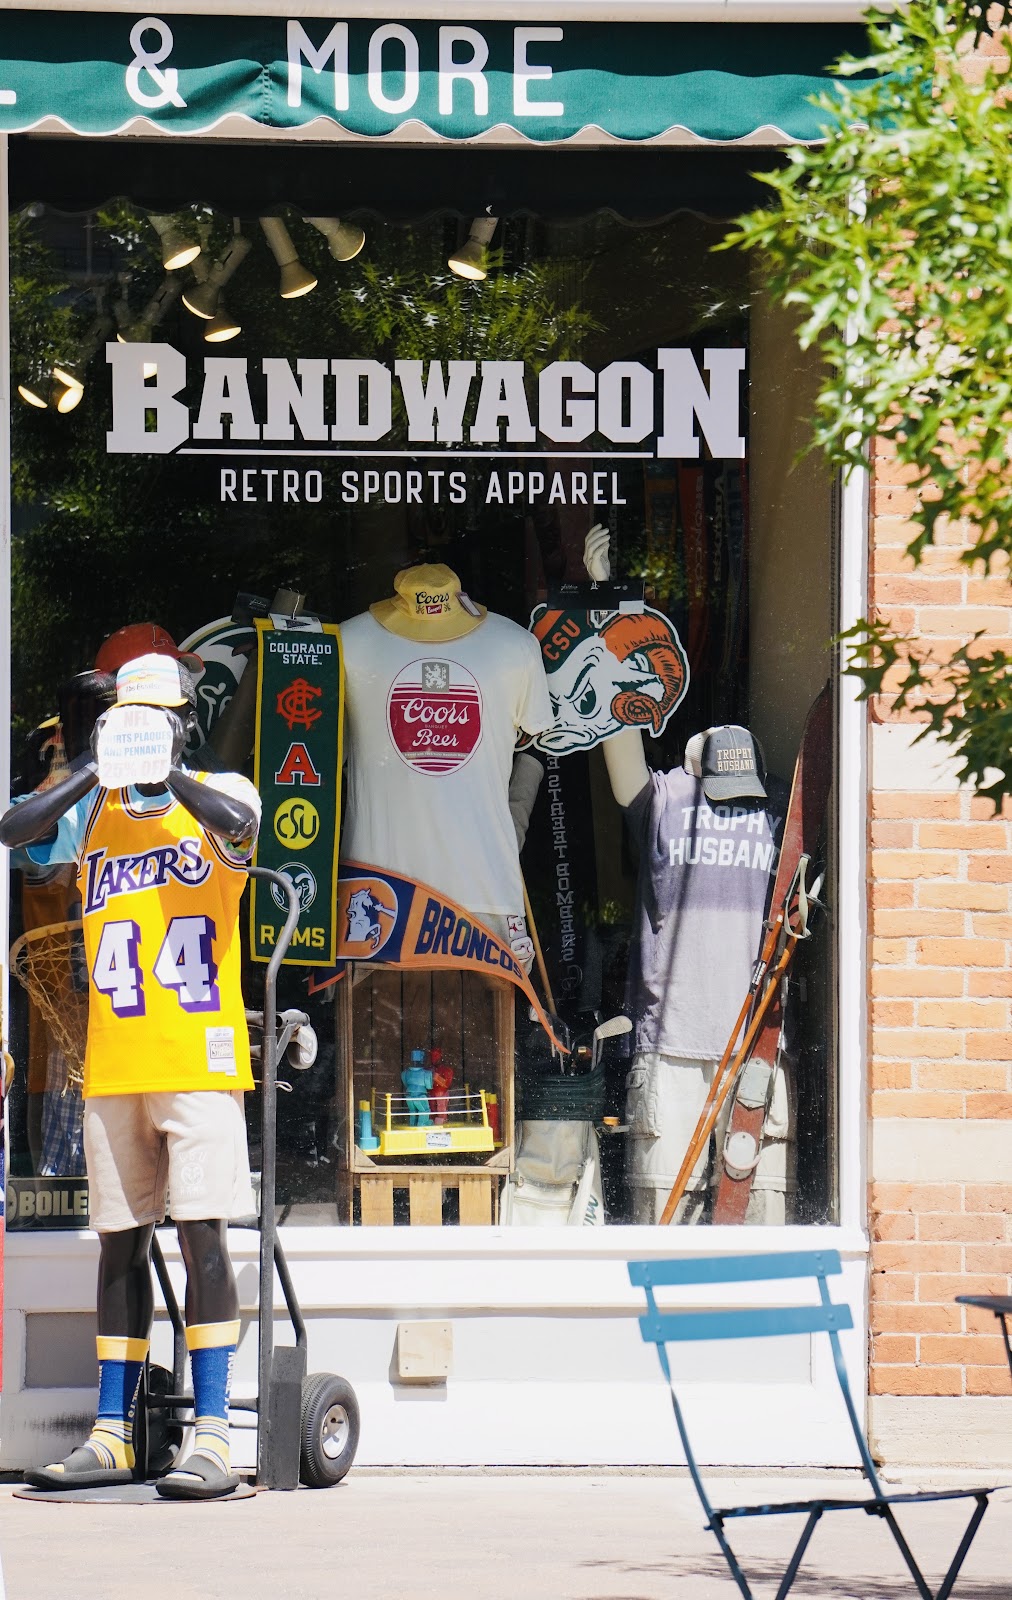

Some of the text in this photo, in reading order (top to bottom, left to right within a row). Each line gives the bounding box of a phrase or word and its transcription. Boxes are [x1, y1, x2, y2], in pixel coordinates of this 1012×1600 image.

[125, 16, 564, 117] & MORE
[105, 342, 747, 459] BANDWAGON
[220, 469, 628, 505] RETRO SPORTS APPAREL
[415, 591, 450, 604] Coors
[269, 642, 332, 655] COLORADO
[543, 618, 581, 661] CSU
[282, 653, 319, 665] STATE
[124, 710, 150, 728] NFL
[401, 698, 470, 725] Coors
[124, 744, 168, 756] PENNANTS
[134, 731, 172, 742] PLAQUES
[412, 728, 460, 747] Beer
[717, 748, 753, 760] TROPHY
[717, 759, 755, 772] HUSBAND
[276, 803, 318, 840] CSU
[682, 805, 783, 838] TROPHY
[84, 837, 213, 916] LAKERS
[414, 898, 524, 980] BRONCOS
[93, 915, 220, 1018] 44
